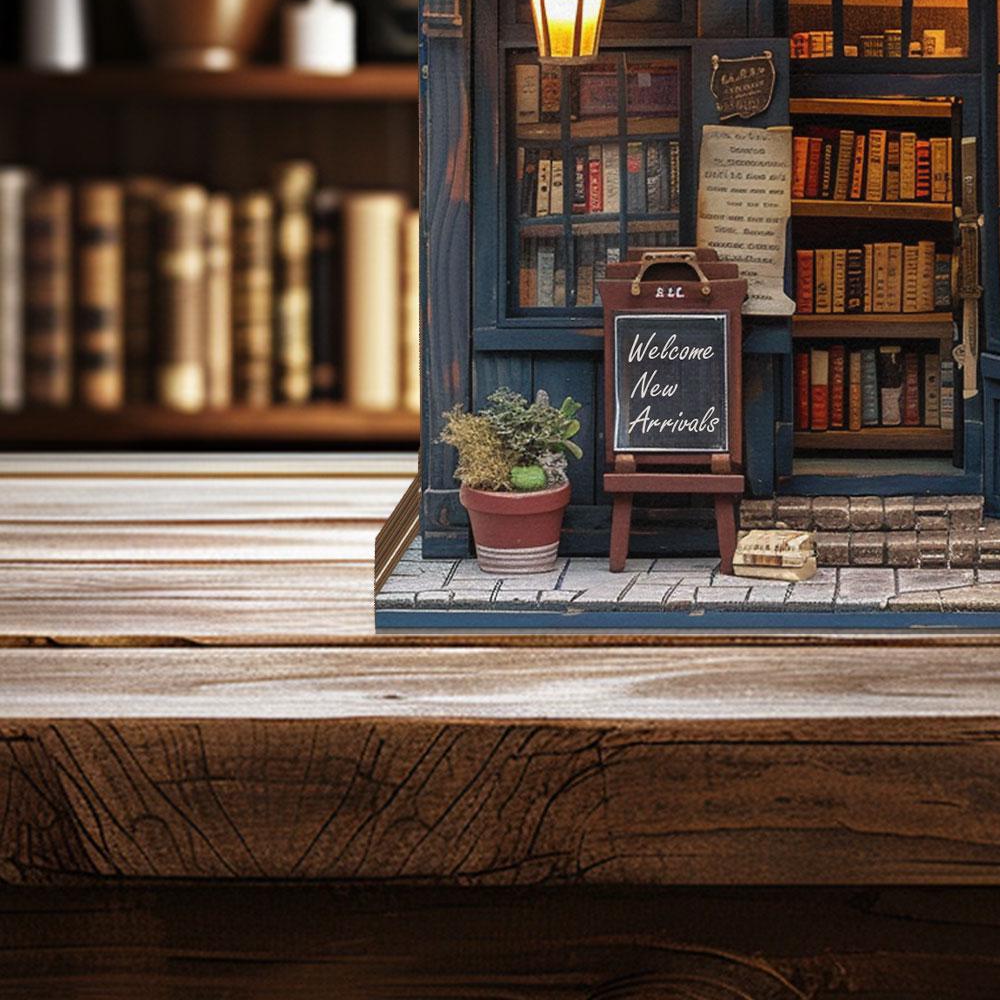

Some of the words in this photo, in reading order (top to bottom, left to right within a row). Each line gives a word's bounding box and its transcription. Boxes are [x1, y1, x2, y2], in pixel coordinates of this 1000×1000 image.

[628, 332, 715, 363] Welcome
[630, 369, 679, 399] New
[627, 405, 720, 434] Arrivals
